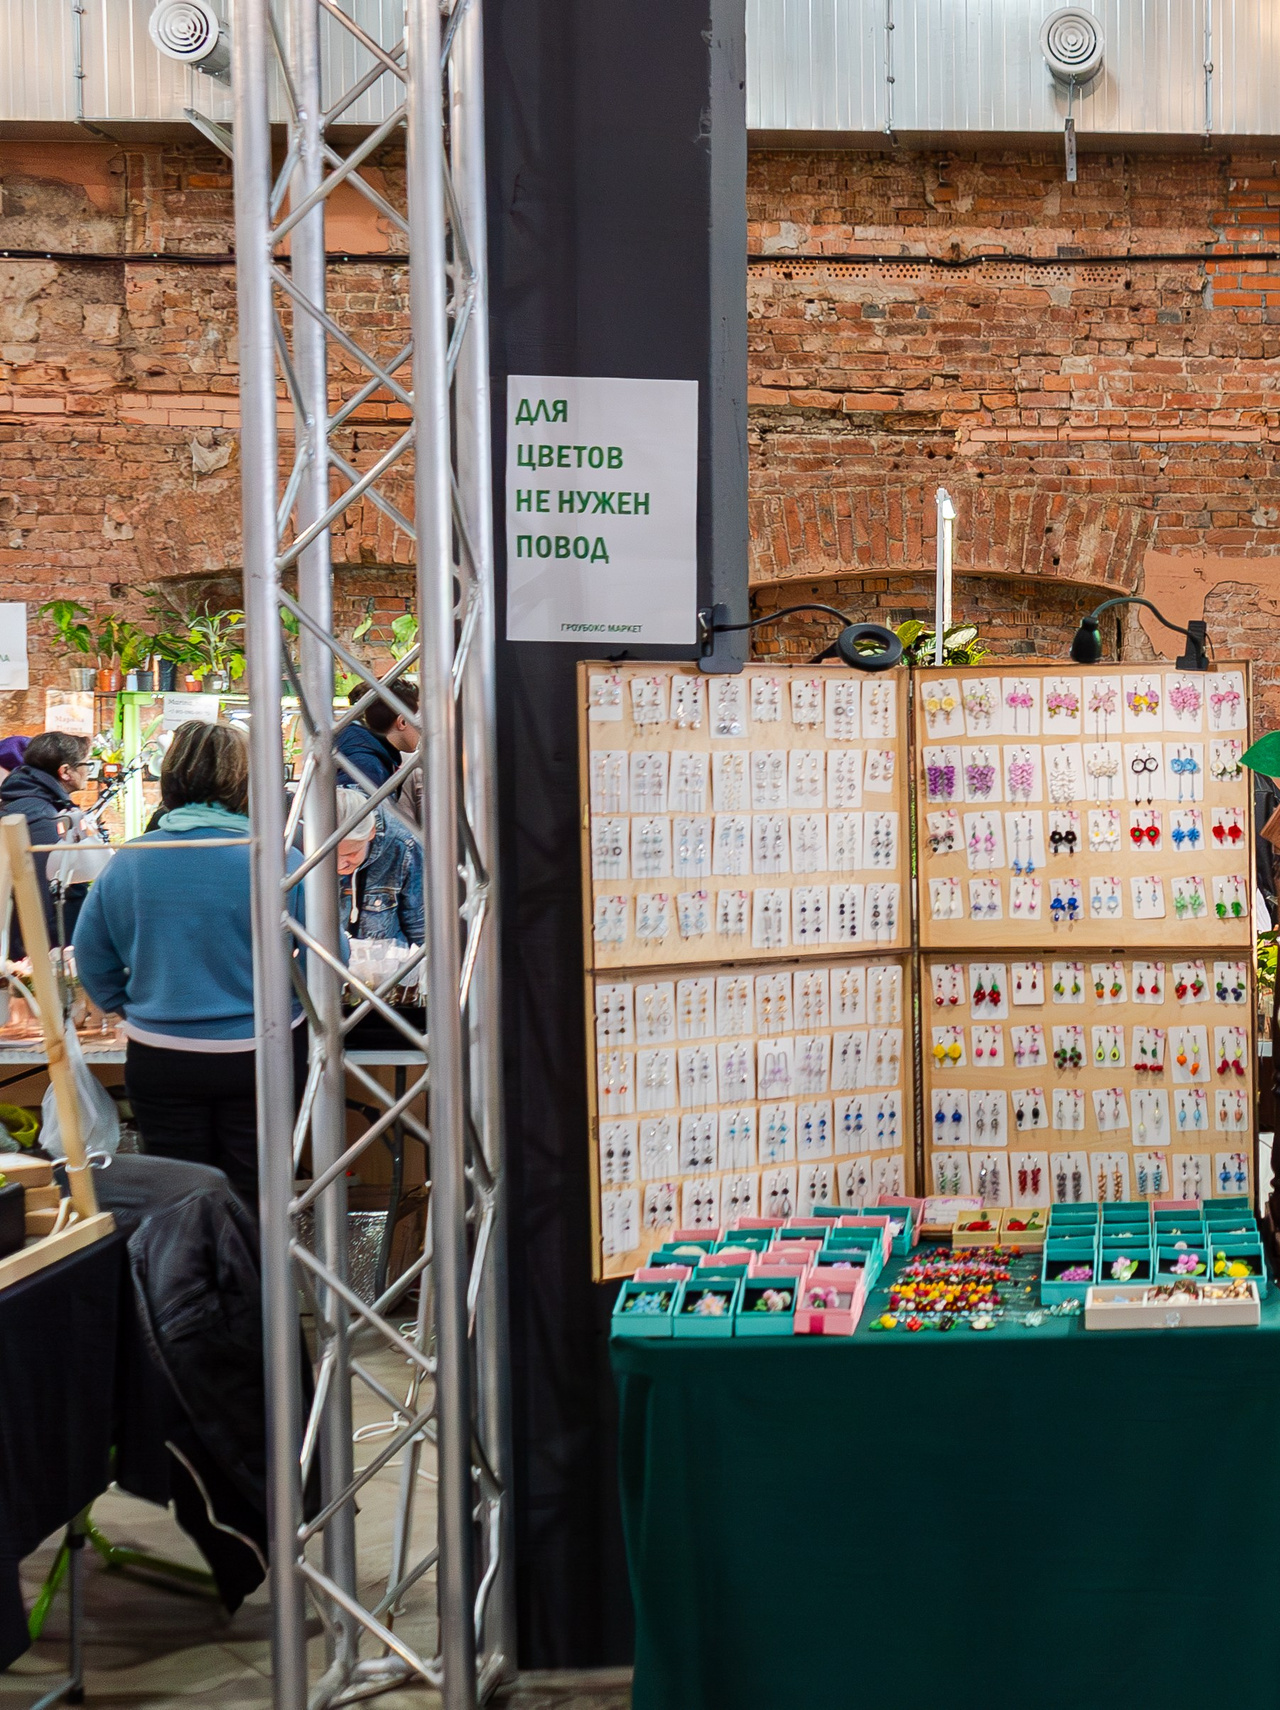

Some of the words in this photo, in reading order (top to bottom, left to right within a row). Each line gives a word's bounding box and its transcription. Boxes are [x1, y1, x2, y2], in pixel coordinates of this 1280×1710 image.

[515, 398, 568, 426] ДЛЯ
[516, 444, 624, 471] ЦВЕТОВ
[515, 489, 551, 513] НЕ
[558, 490, 650, 515] НУЖЕН
[516, 535, 610, 564] ПОВОД
[608, 624, 643, 633] МАРКЕТ
